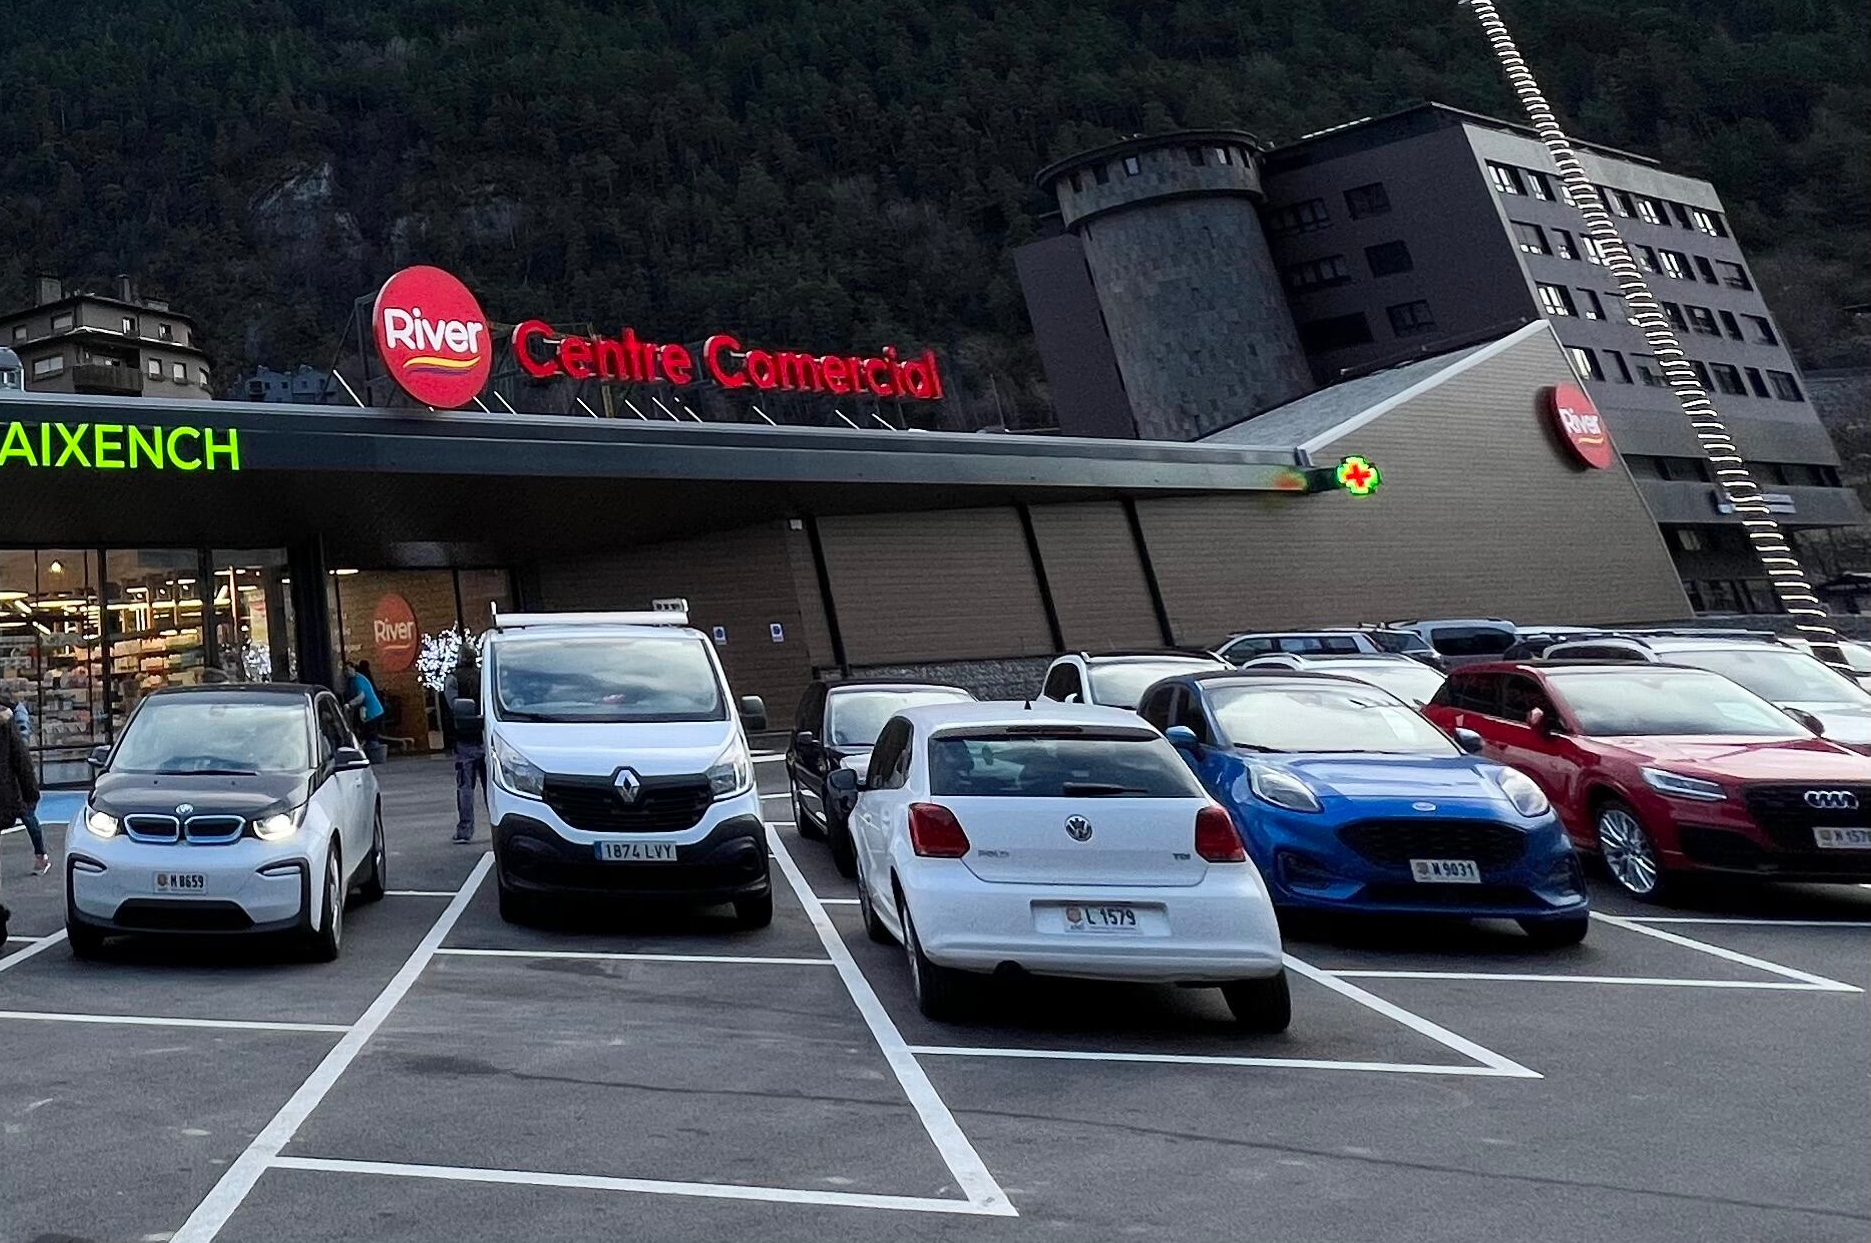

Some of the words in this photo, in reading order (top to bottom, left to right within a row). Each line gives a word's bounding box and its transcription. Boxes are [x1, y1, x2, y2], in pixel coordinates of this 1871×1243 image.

[383, 307, 483, 354] River
[512, 320, 691, 385] Centre
[703, 334, 943, 400] Comercial
[1558, 407, 1602, 435] River
[373, 617, 415, 643] River
[606, 844, 640, 858] 1874
[644, 844, 671, 858] LVY
[1442, 862, 1475, 876] 9031
[1085, 908, 1096, 925] L
[1099, 908, 1136, 925] 1579
